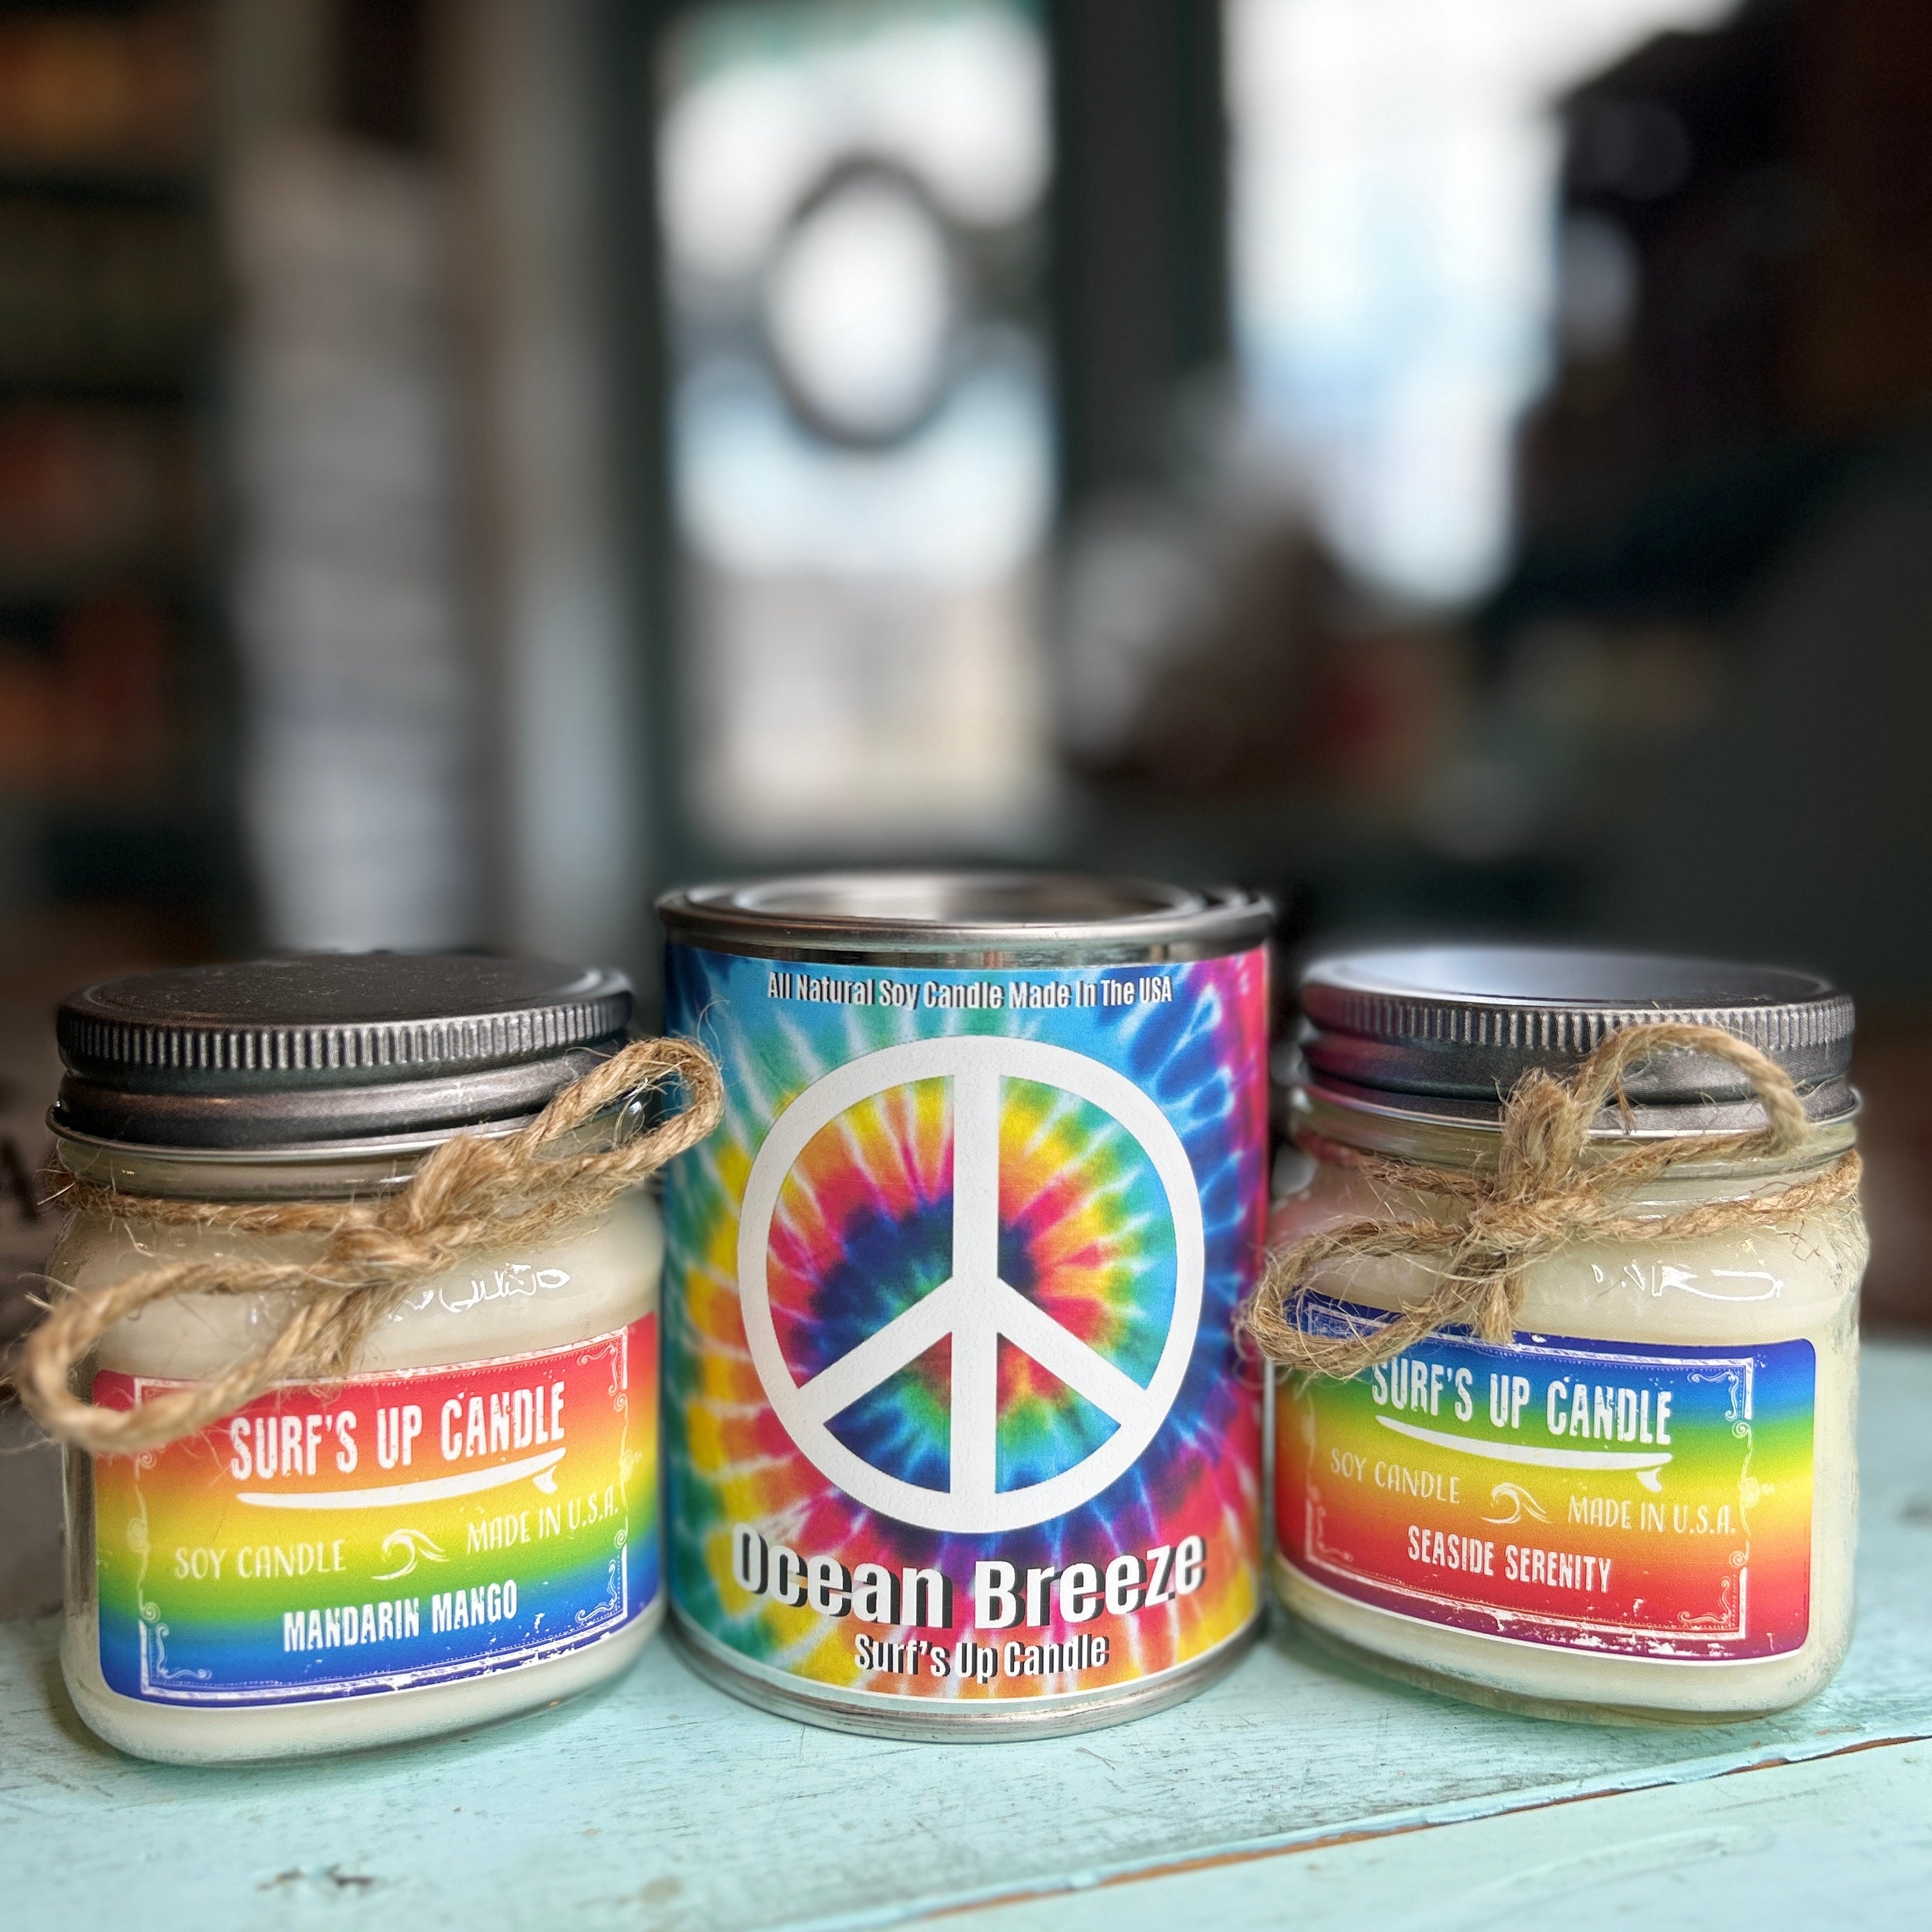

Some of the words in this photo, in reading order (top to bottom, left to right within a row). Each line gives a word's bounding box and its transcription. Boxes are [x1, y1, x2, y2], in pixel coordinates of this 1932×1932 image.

[769, 971, 792, 999] All
[797, 975, 875, 1006] Natural
[878, 978, 919, 1011] Soy
[923, 981, 1005, 1009] Candle
[1009, 980, 1071, 1009] Made
[1077, 979, 1097, 1006] In
[1101, 979, 1136, 1006] The
[1139, 976, 1172, 1002] USA
[230, 1410, 358, 1481] SURF'S
[377, 1404, 422, 1469] UP
[441, 1381, 566, 1460] CANDLE
[1372, 1356, 1473, 1422] SURF'S
[1489, 1374, 1529, 1429] UP
[1546, 1380, 1672, 1445] CANDLE
[1331, 1447, 1365, 1483] SOY
[1374, 1460, 1460, 1504] CANDLE
[467, 1512, 530, 1554] MADE
[539, 1510, 562, 1538] IN
[567, 1484, 620, 1531] U.S.A.
[1568, 1495, 1631, 1529] MADE
[1640, 1501, 1664, 1534] IN
[1673, 1505, 1736, 1535] U.S.A.
[174, 1546, 224, 1578] SOY
[237, 1538, 347, 1578] CANDLE
[733, 1523, 953, 1629] Ocean
[974, 1535, 1206, 1629] Breeze
[1407, 1525, 1494, 1576] SEASIDE
[1505, 1544, 1612, 1593] SERENITY
[284, 1596, 420, 1653] MANDARIN
[431, 1579, 518, 1633] MANGO
[855, 1633, 951, 1676] Surf's
[954, 1641, 997, 1684] Up
[1003, 1634, 1109, 1676] Candle
